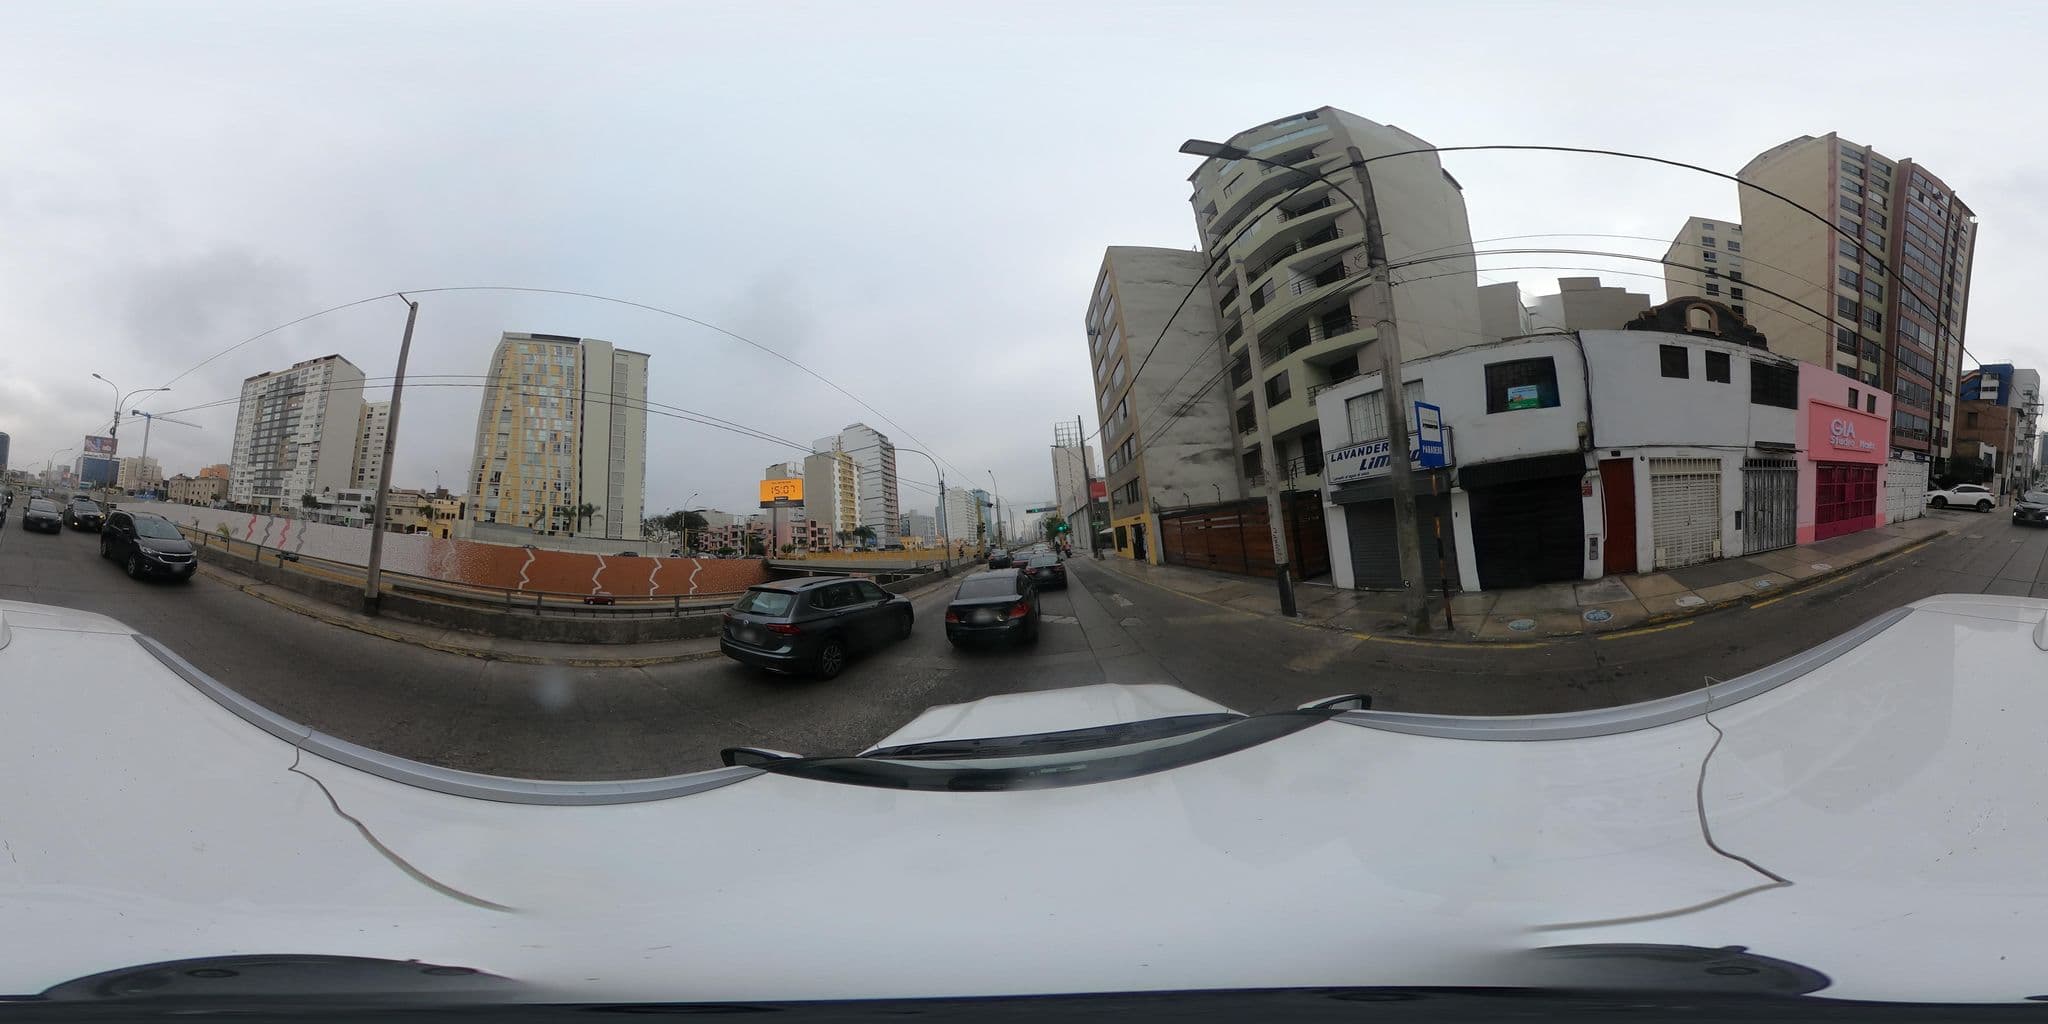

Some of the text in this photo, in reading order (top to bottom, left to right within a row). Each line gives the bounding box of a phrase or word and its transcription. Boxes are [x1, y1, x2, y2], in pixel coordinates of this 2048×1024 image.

[1831, 419, 1856, 438] GIA
[1331, 441, 1400, 462] LAVANDER
[770, 484, 796, 495] 15:07
